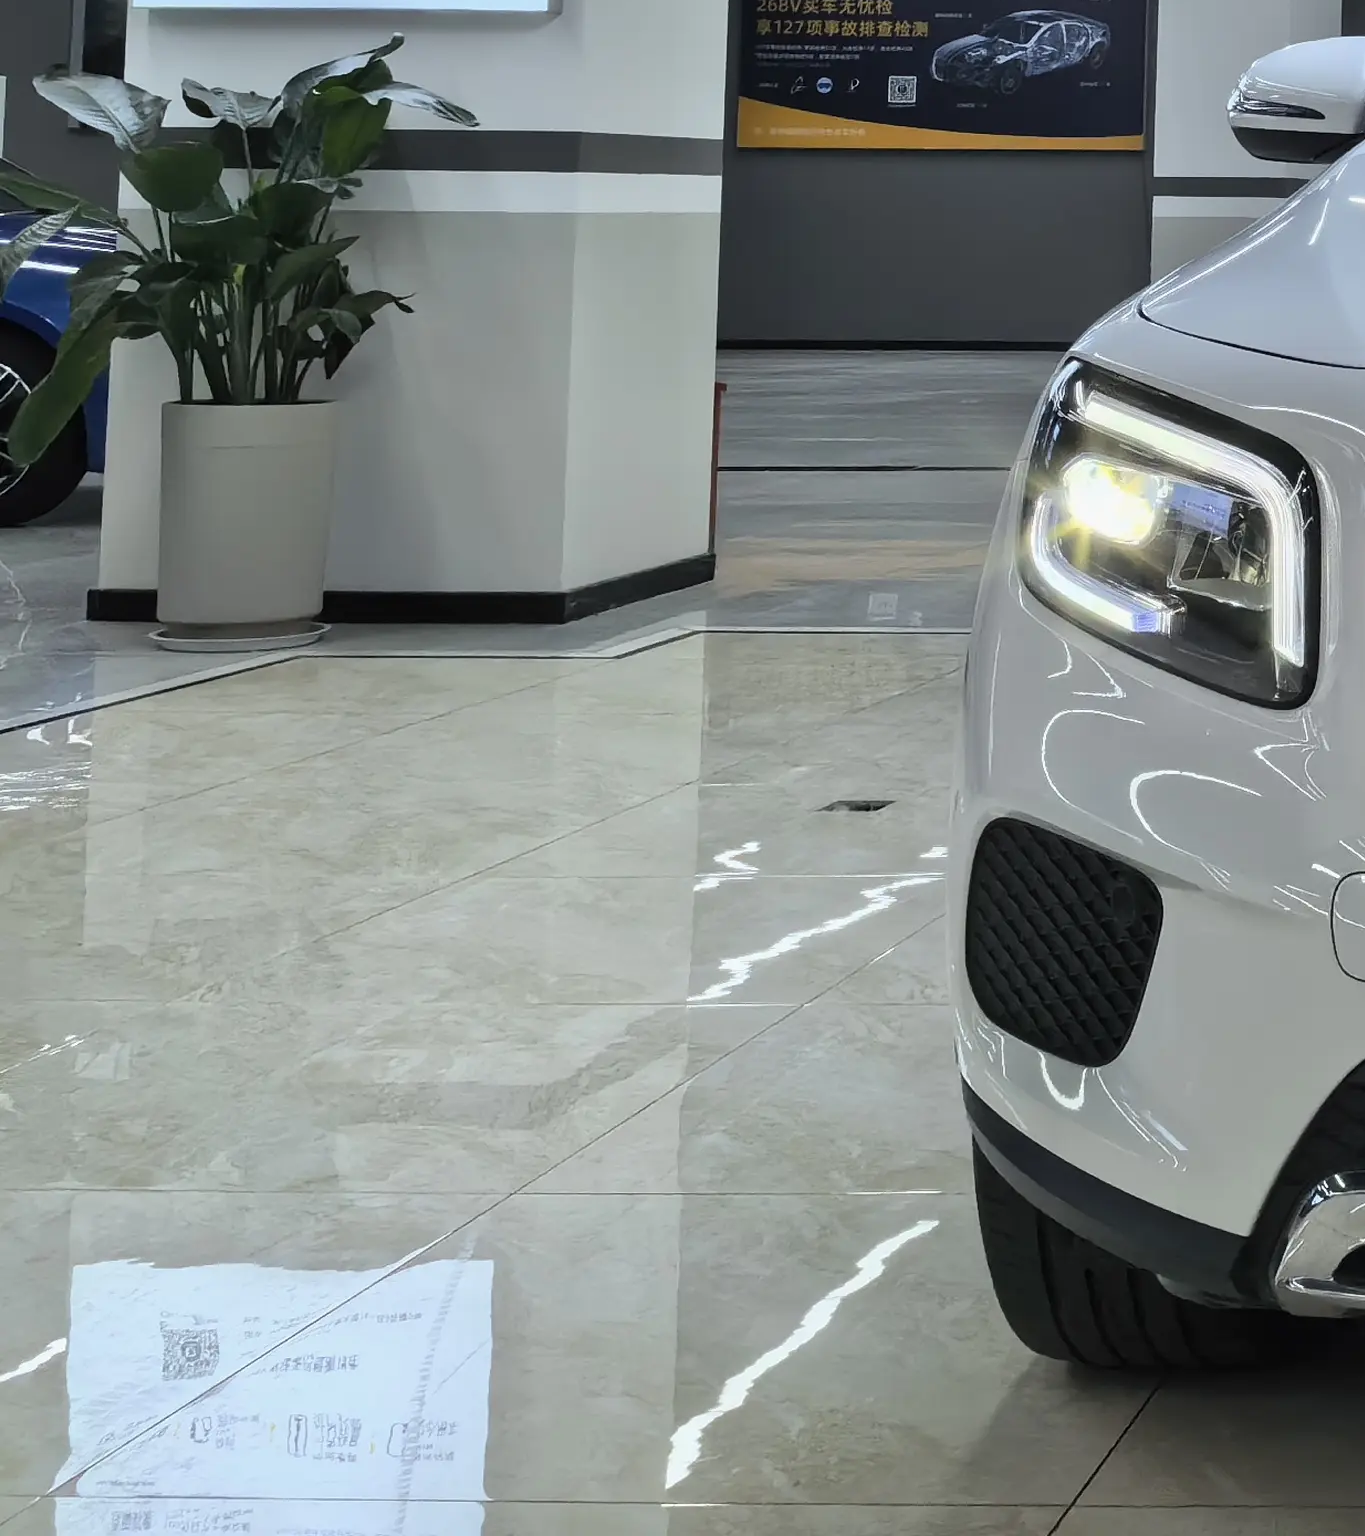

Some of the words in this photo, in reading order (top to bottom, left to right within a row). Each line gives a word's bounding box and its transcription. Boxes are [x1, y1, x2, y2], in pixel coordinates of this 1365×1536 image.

[756, 18, 929, 38] 享127项事故排查检测
